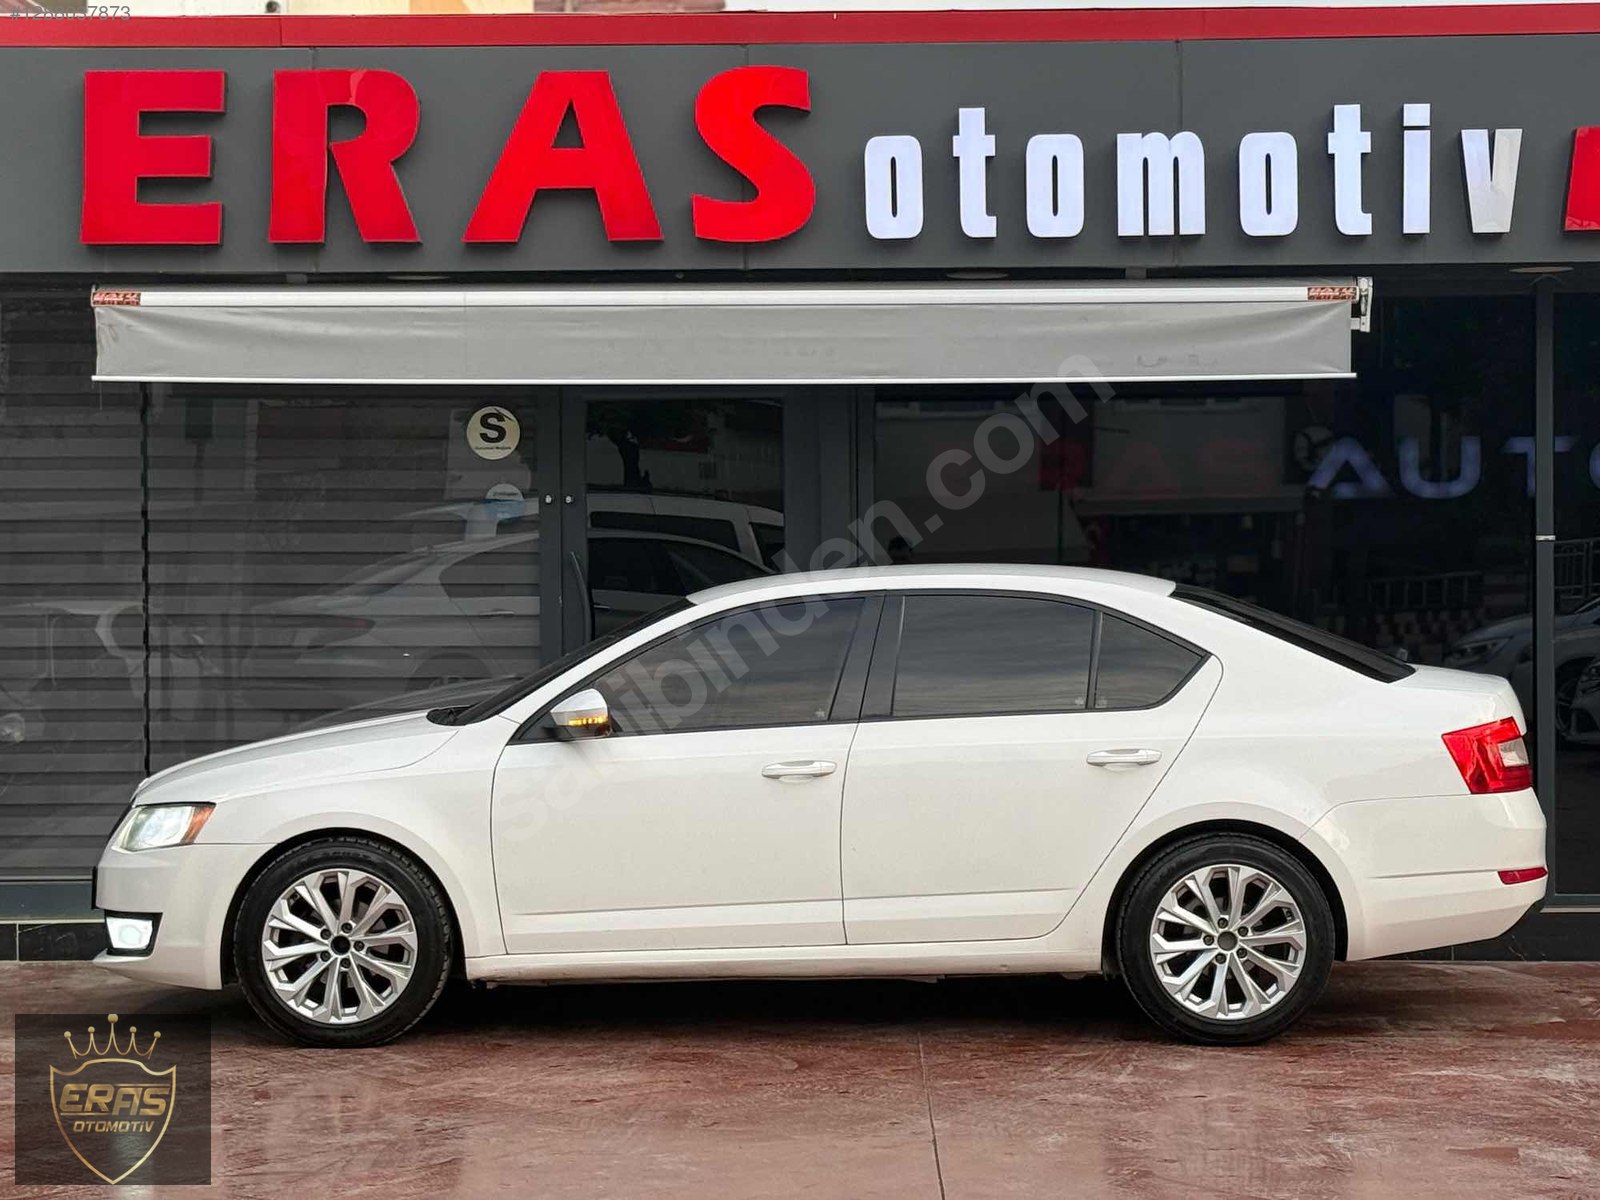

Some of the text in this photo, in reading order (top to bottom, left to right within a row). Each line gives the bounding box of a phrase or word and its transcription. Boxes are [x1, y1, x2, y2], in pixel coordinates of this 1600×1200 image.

[80, 65, 817, 245] ERAS
[864, 103, 1523, 240] otomotiv
[1306, 435, 1600, 500] AUT
